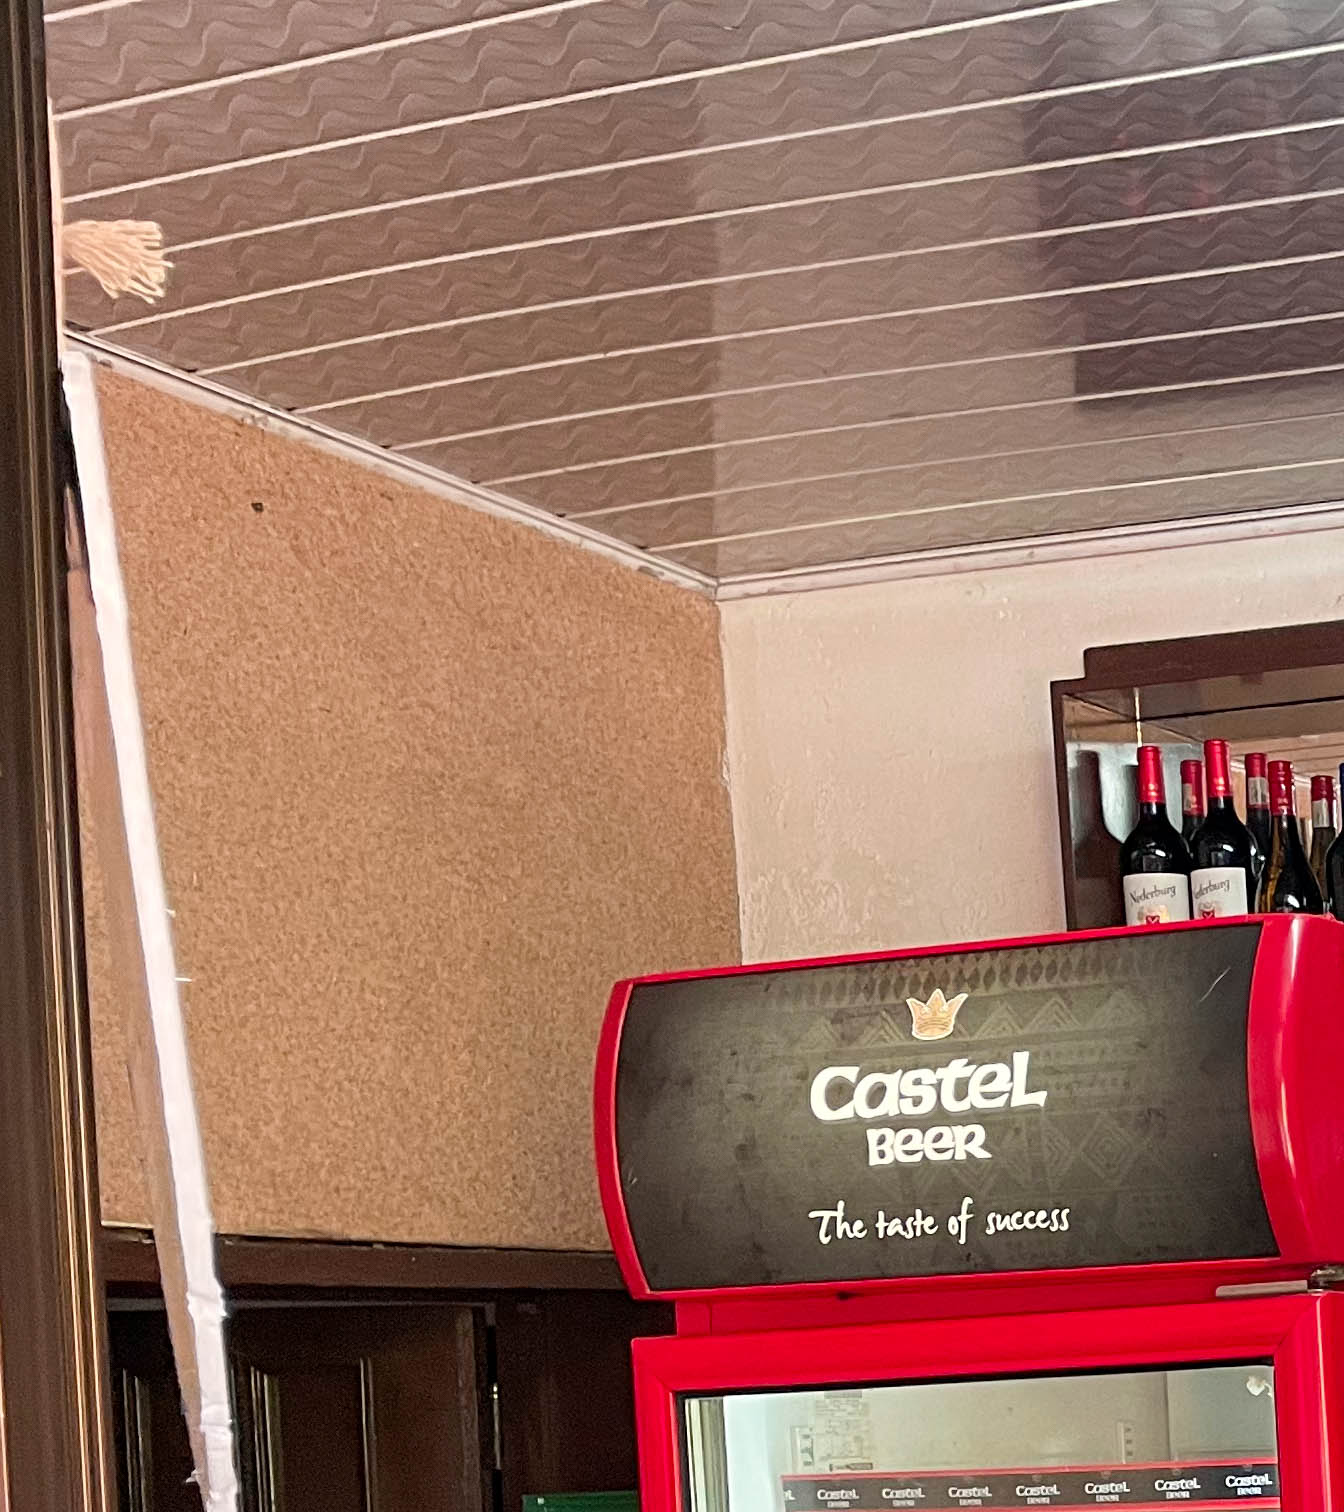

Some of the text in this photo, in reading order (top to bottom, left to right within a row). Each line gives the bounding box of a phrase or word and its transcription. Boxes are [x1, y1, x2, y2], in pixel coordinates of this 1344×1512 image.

[1130, 885, 1177, 903] Nederburg
[1194, 880, 1231, 899] ederburg
[809, 1051, 1047, 1121] Castel
[866, 1124, 993, 1166] BEER
[808, 1197, 1071, 1245] The taste of success
[1225, 1473, 1273, 1488] Castel
